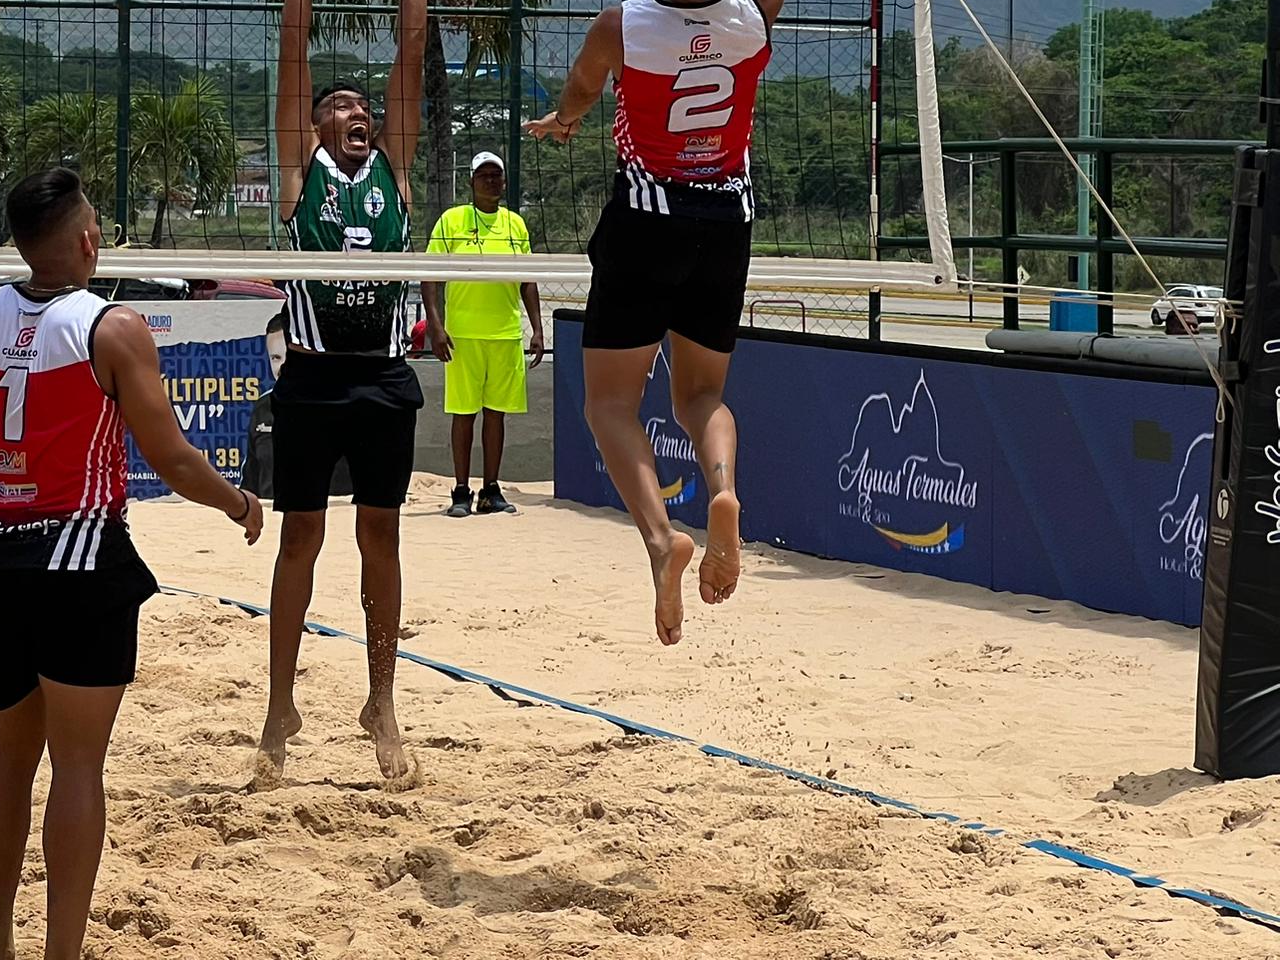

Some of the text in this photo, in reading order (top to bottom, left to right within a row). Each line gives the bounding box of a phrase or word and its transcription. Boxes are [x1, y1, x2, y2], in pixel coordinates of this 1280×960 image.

[667, 65, 736, 135] 2
[335, 291, 376, 307] 2025
[215, 447, 240, 468] 39
[838, 447, 978, 508] Aguas Termales
